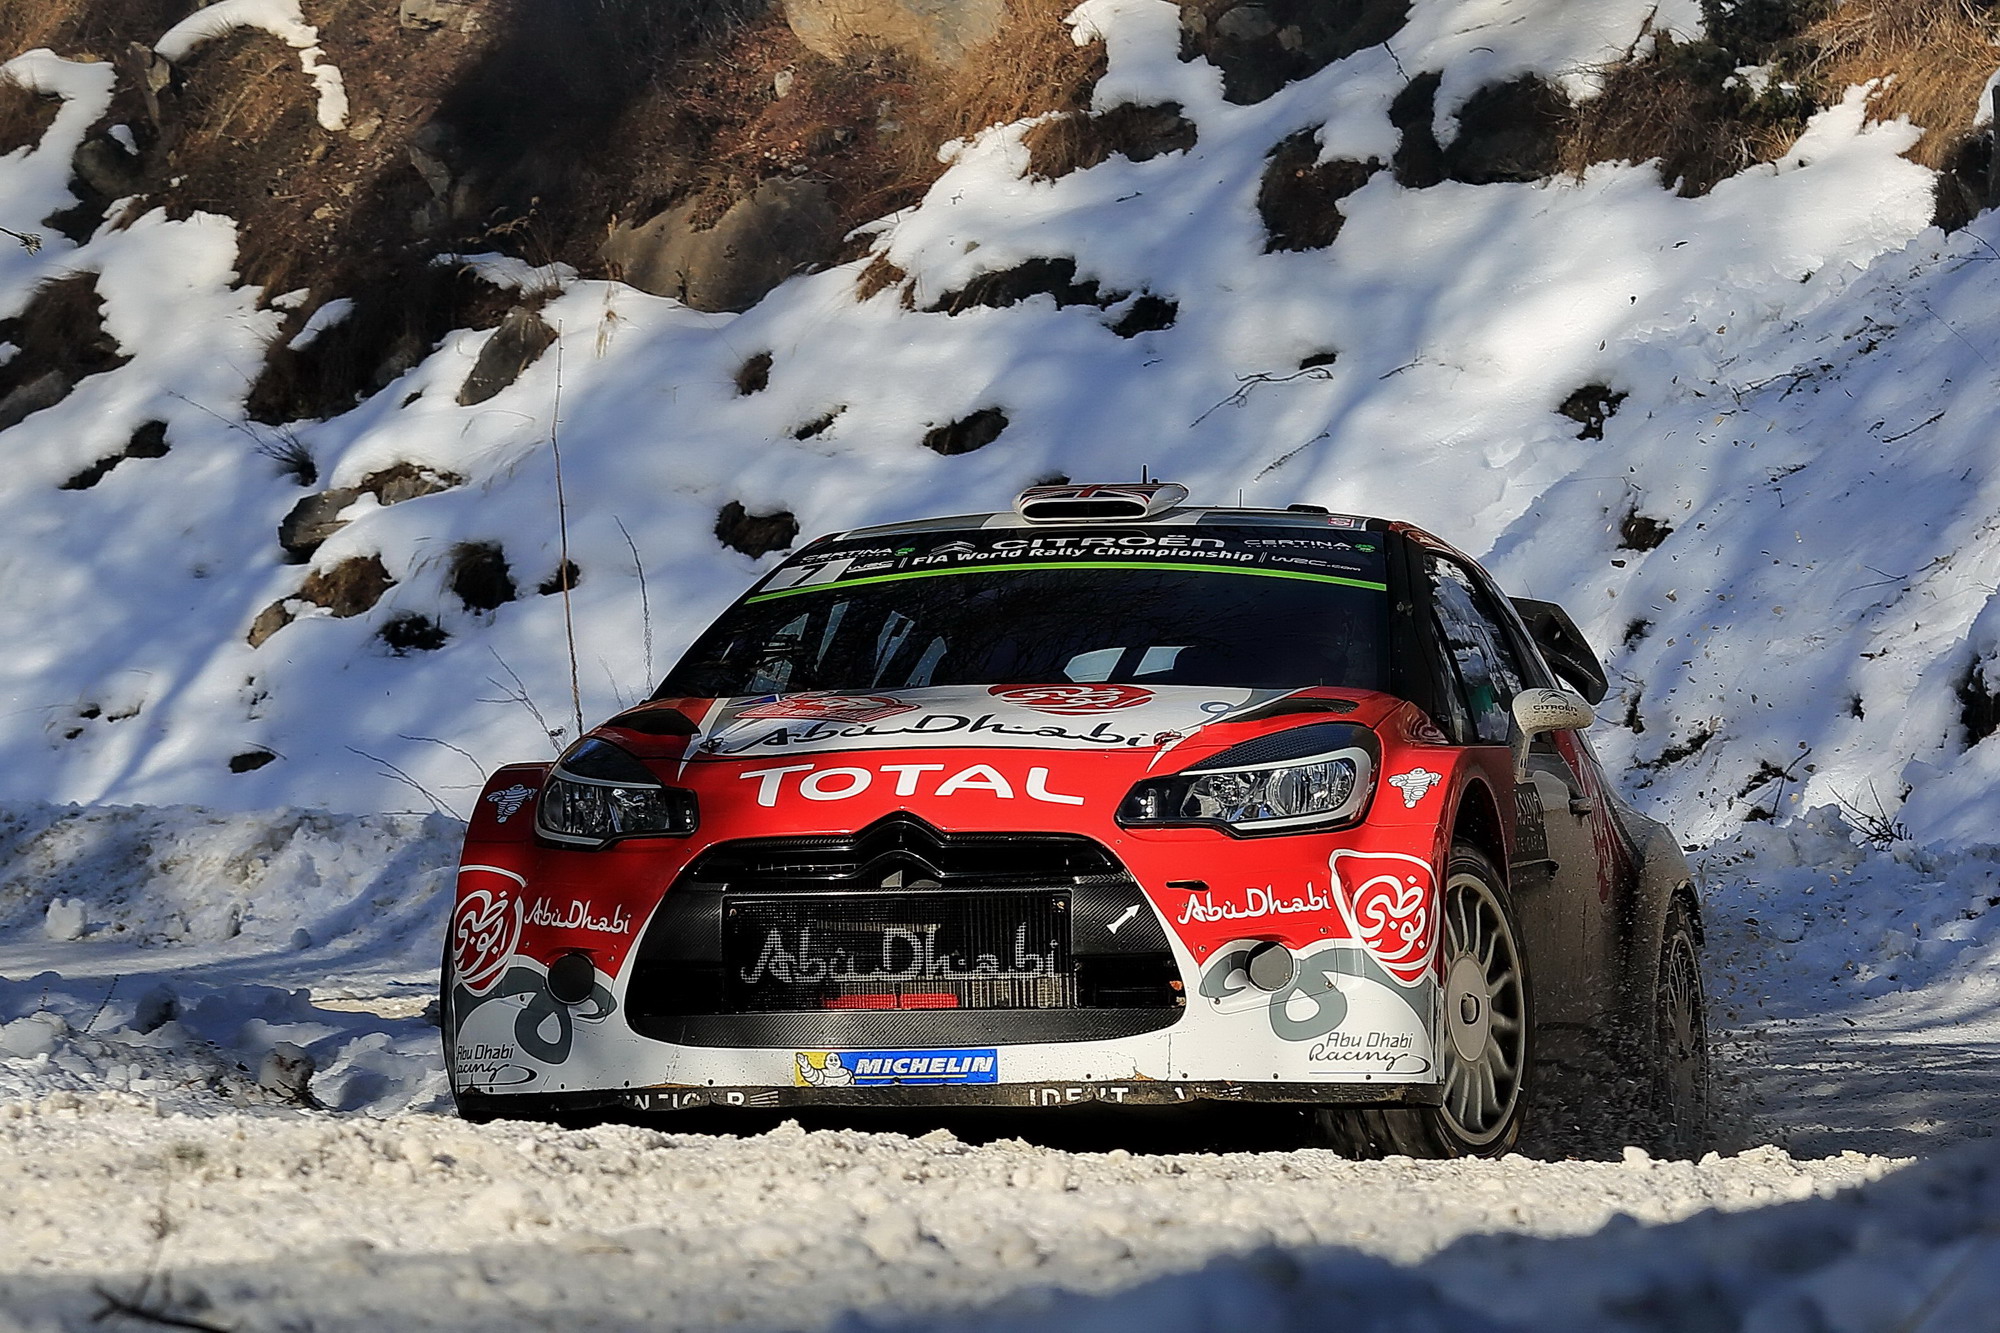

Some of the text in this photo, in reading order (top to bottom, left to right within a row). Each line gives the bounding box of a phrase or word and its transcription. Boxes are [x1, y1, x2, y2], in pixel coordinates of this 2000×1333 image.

[991, 534, 1226, 549] CITROËN
[1244, 539, 1352, 549] CERTINA
[802, 547, 892, 561] CERTINA
[912, 554, 948, 566] FIA
[957, 549, 1022, 561] World
[1028, 547, 1087, 557] Rally
[1093, 547, 1254, 562] Championship
[723, 713, 1147, 753] Abu Dhabi
[739, 763, 1084, 806] TOTAL
[1177, 882, 1332, 924] Abu Dhabi
[524, 897, 631, 935] Abu Dhabi
[740, 922, 1061, 983] Abu Dhabi
[1326, 1031, 1414, 1049] Abu Dhabi
[475, 1043, 515, 1060] Dhabi
[1308, 1044, 1410, 1071] Racing
[855, 1056, 994, 1074] MICHELIN
